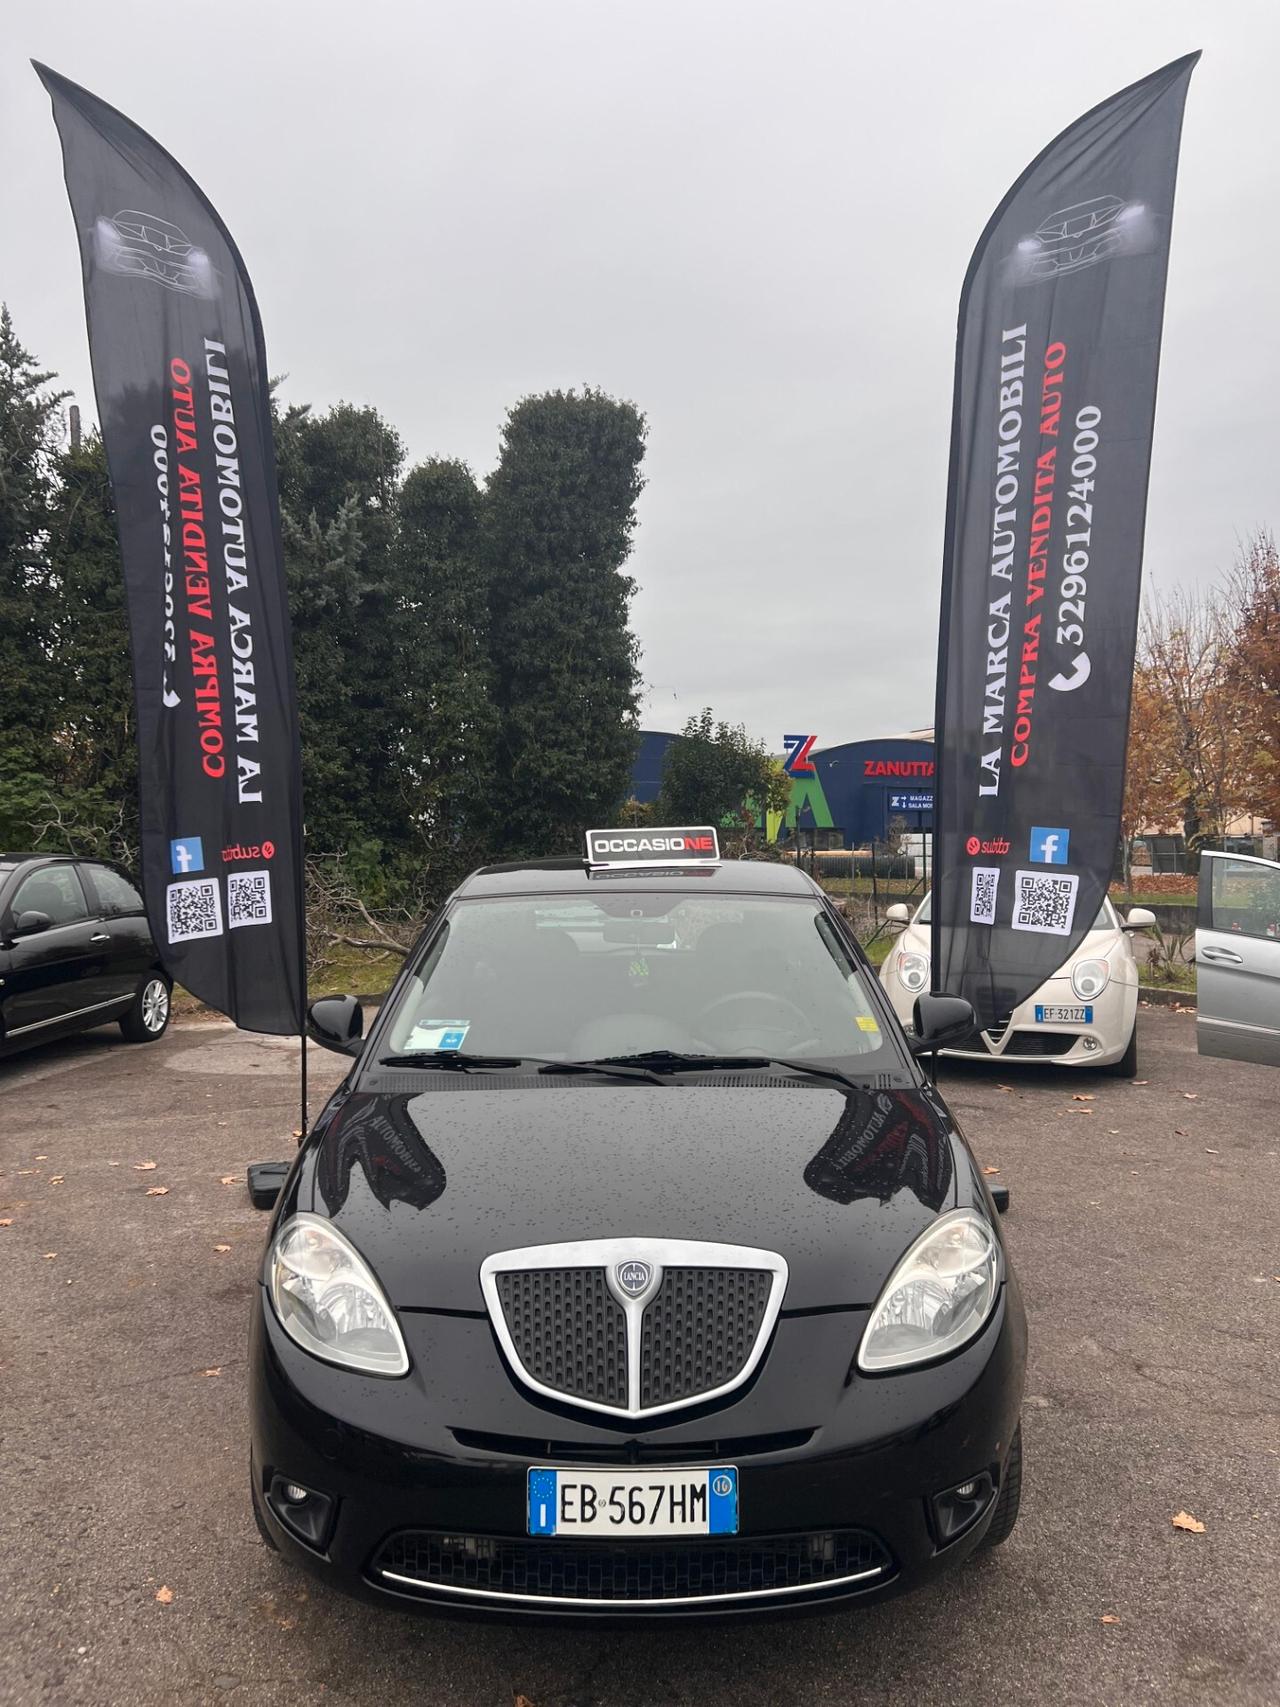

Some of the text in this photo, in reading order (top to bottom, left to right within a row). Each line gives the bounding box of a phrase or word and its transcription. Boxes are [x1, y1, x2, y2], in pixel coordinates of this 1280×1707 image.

[979, 322, 1027, 797] LA MARCA AUTOMOBILI
[1011, 341, 1067, 768] COMPRA VENDITA AUTO
[1056, 405, 1101, 647] 3296124000
[594, 837, 713, 853] OCCASIONE
[624, 1271, 645, 1281] LANCIA
[561, 1484, 707, 1525] EB 567HM
